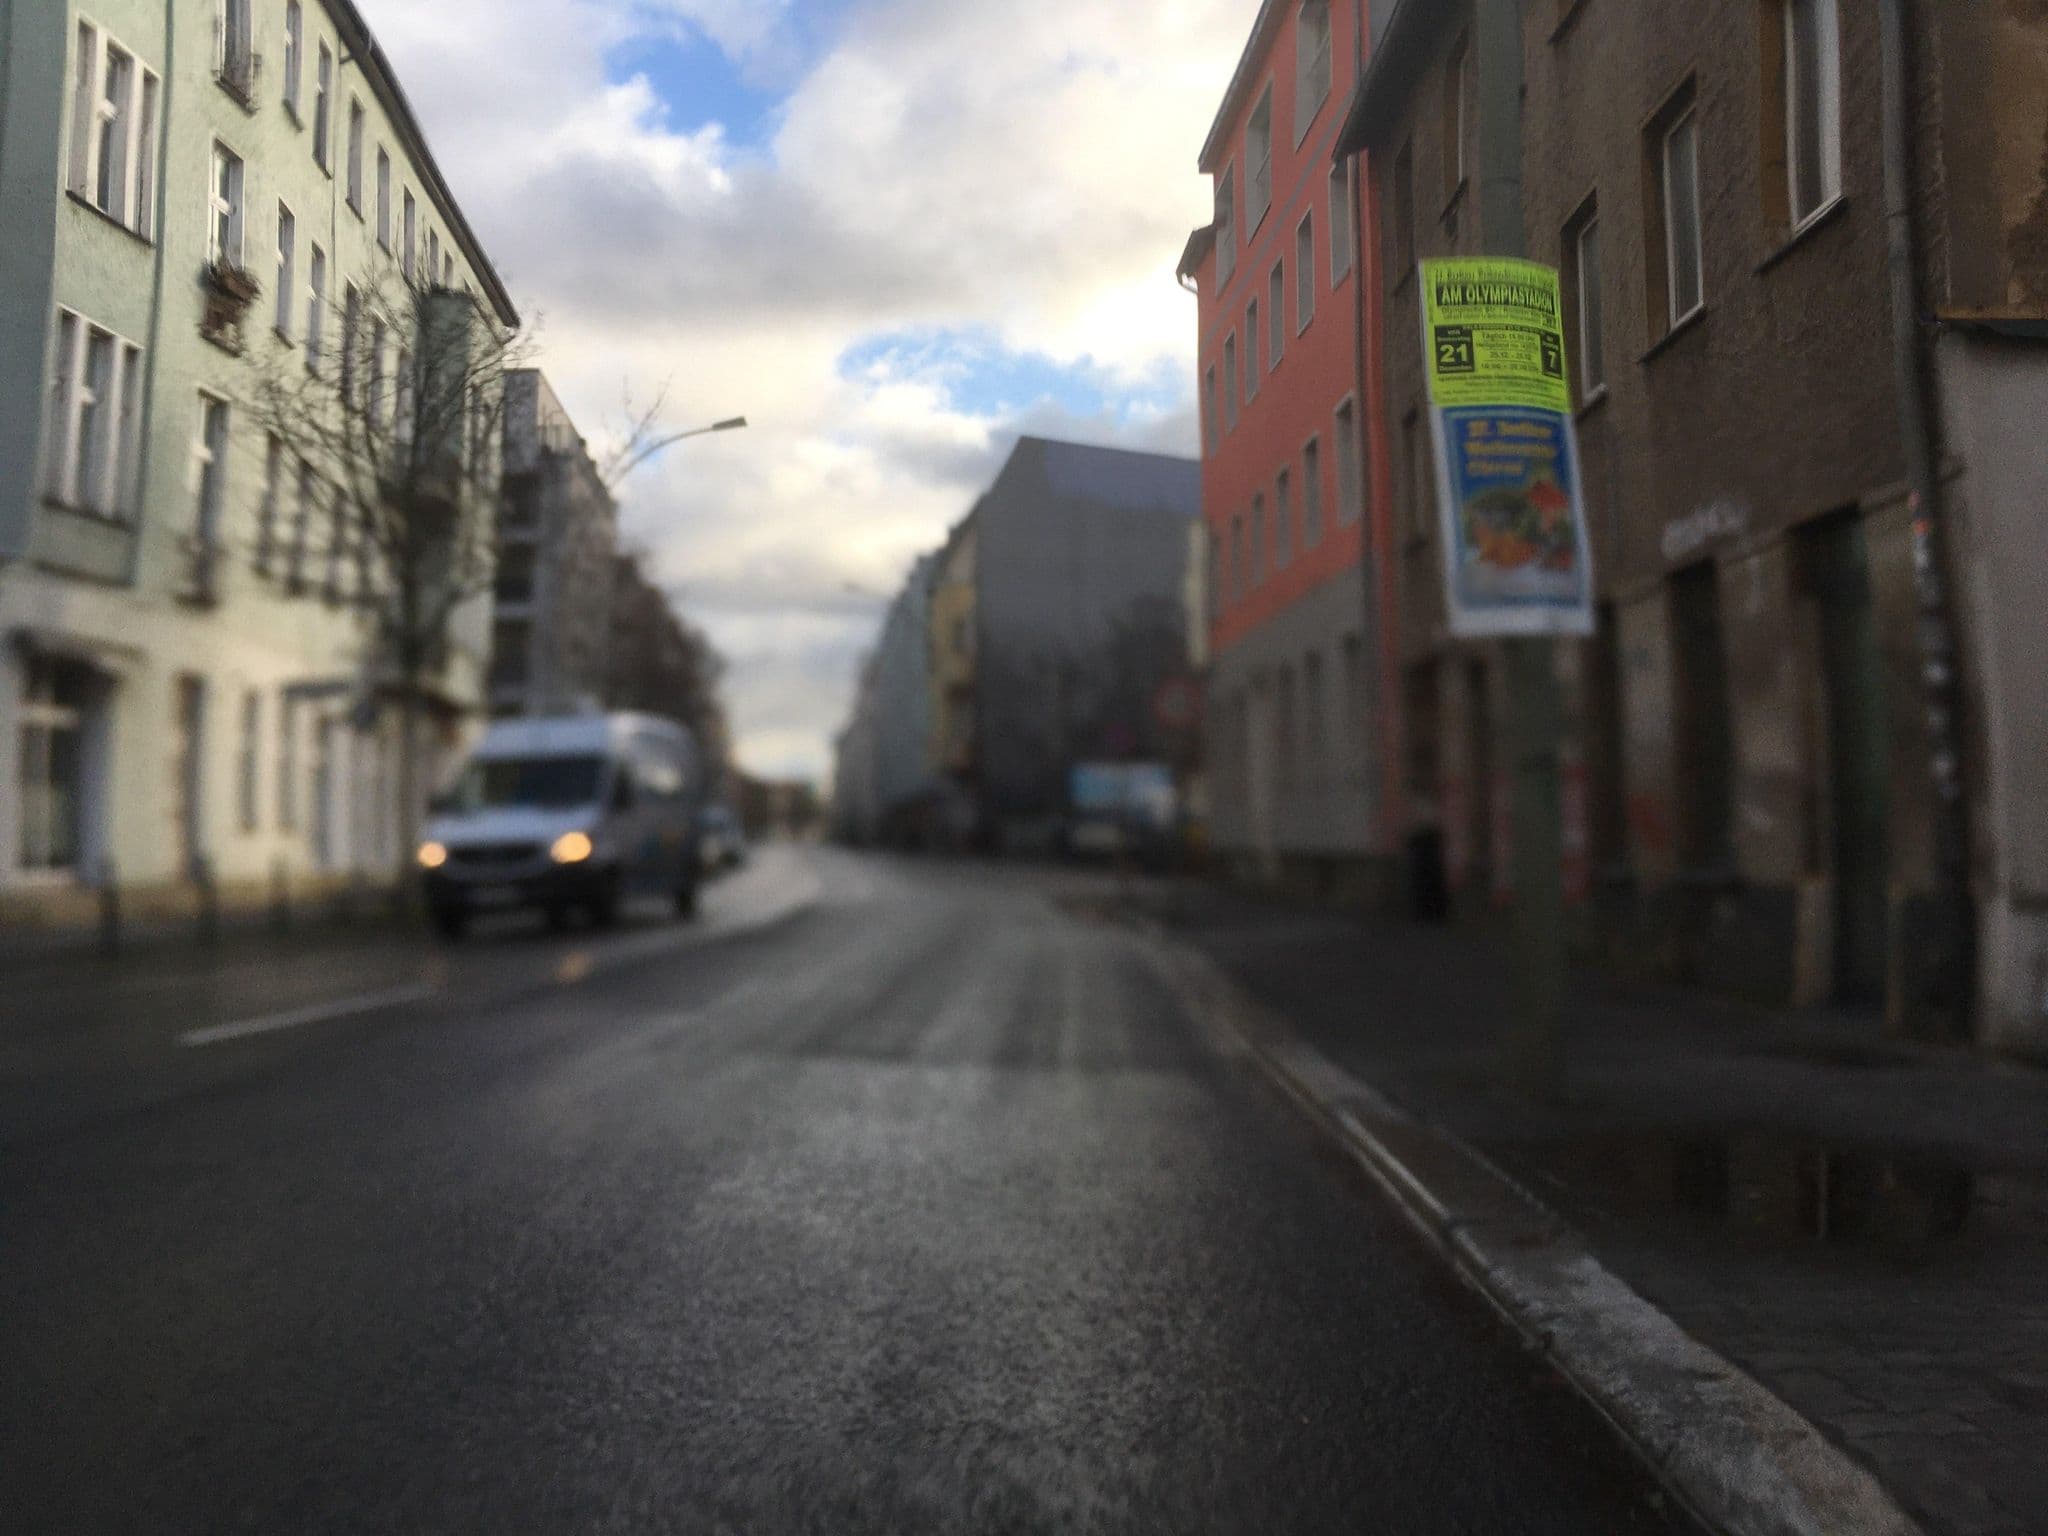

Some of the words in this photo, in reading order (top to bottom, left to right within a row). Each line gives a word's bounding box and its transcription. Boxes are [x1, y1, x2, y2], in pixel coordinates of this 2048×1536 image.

[1442, 284, 1462, 304] AM
[1466, 283, 1553, 312] OLYMPIASTADION
[1440, 343, 1468, 363] 21
[1547, 350, 1556, 368] 7
